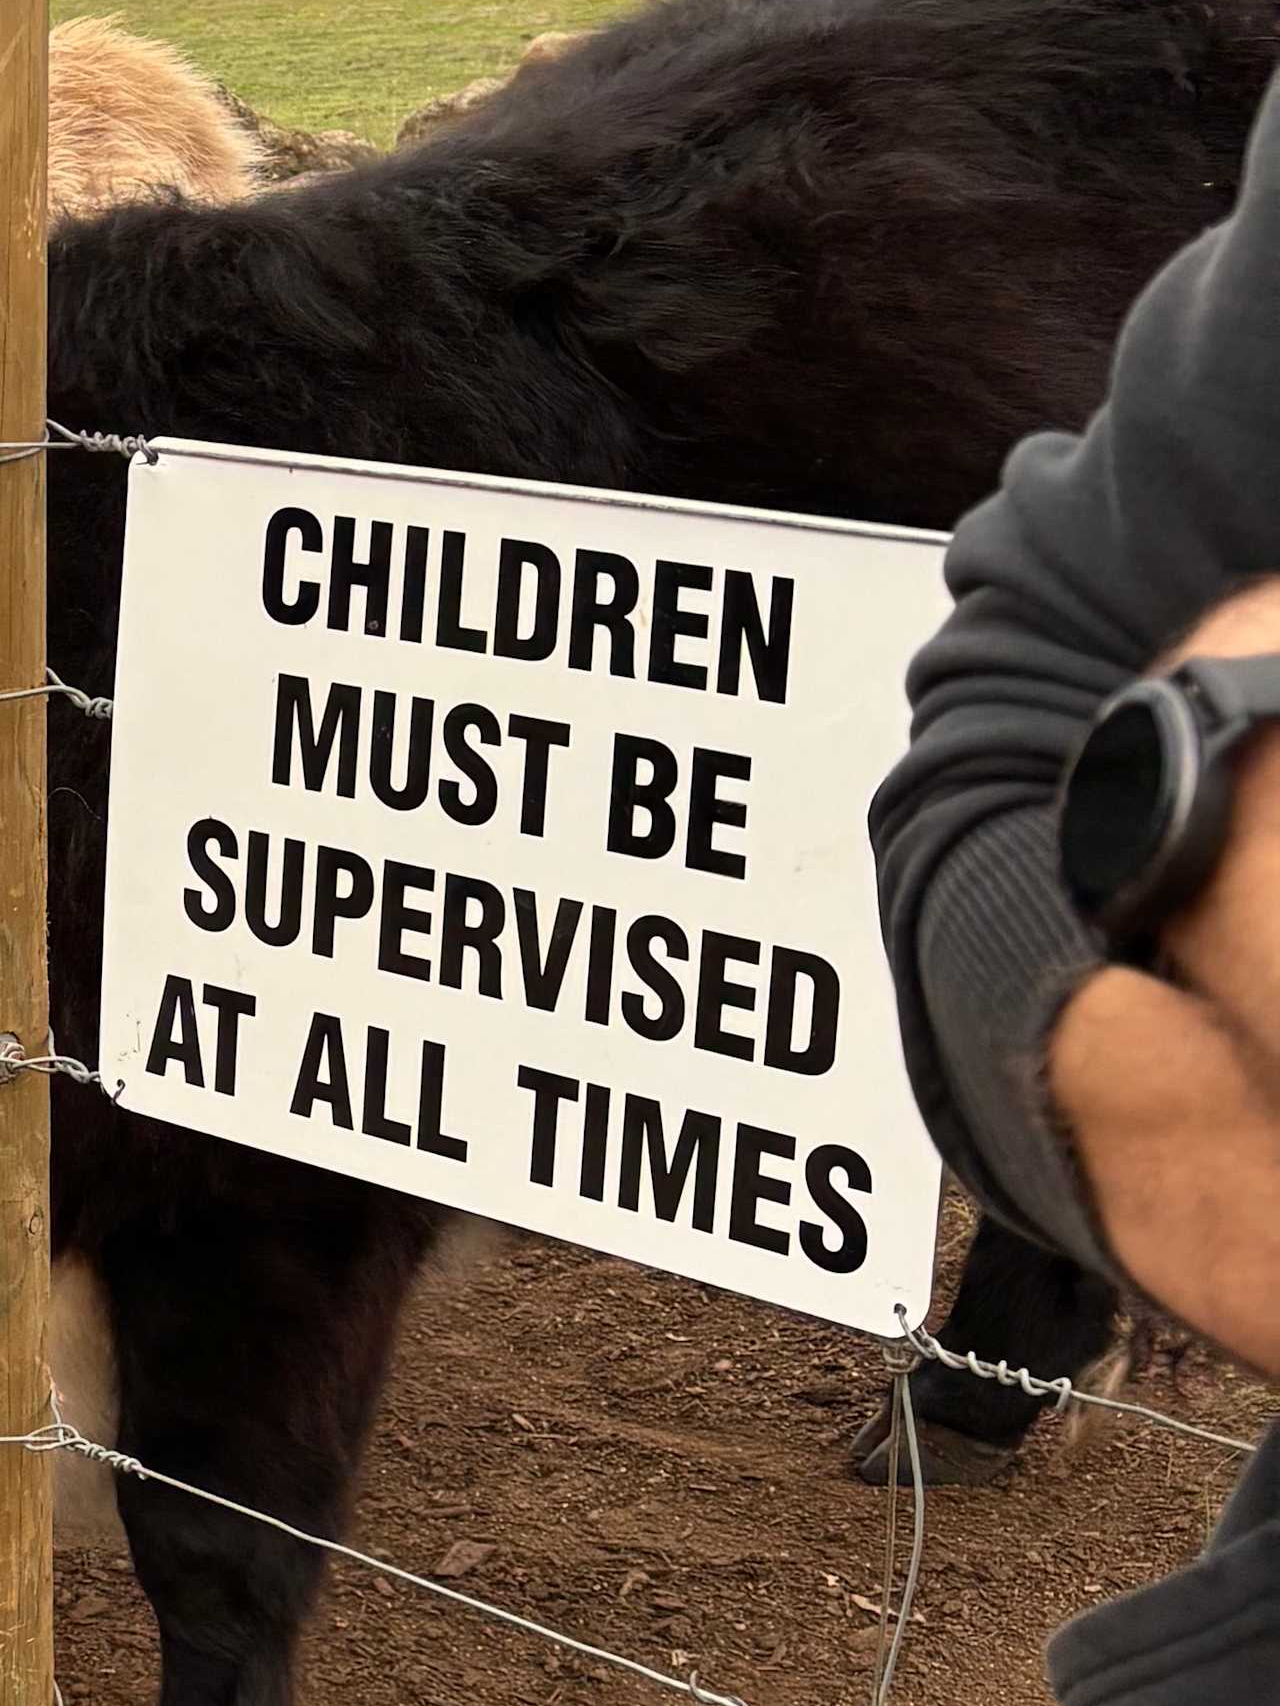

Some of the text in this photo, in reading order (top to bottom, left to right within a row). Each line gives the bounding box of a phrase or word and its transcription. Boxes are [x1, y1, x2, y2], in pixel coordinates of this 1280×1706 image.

[261, 506, 796, 705] CHILDREN
[271, 673, 752, 880] MUST BE
[183, 818, 842, 1077] SUPERVISED
[144, 974, 873, 1274] AT ALL TIMES
